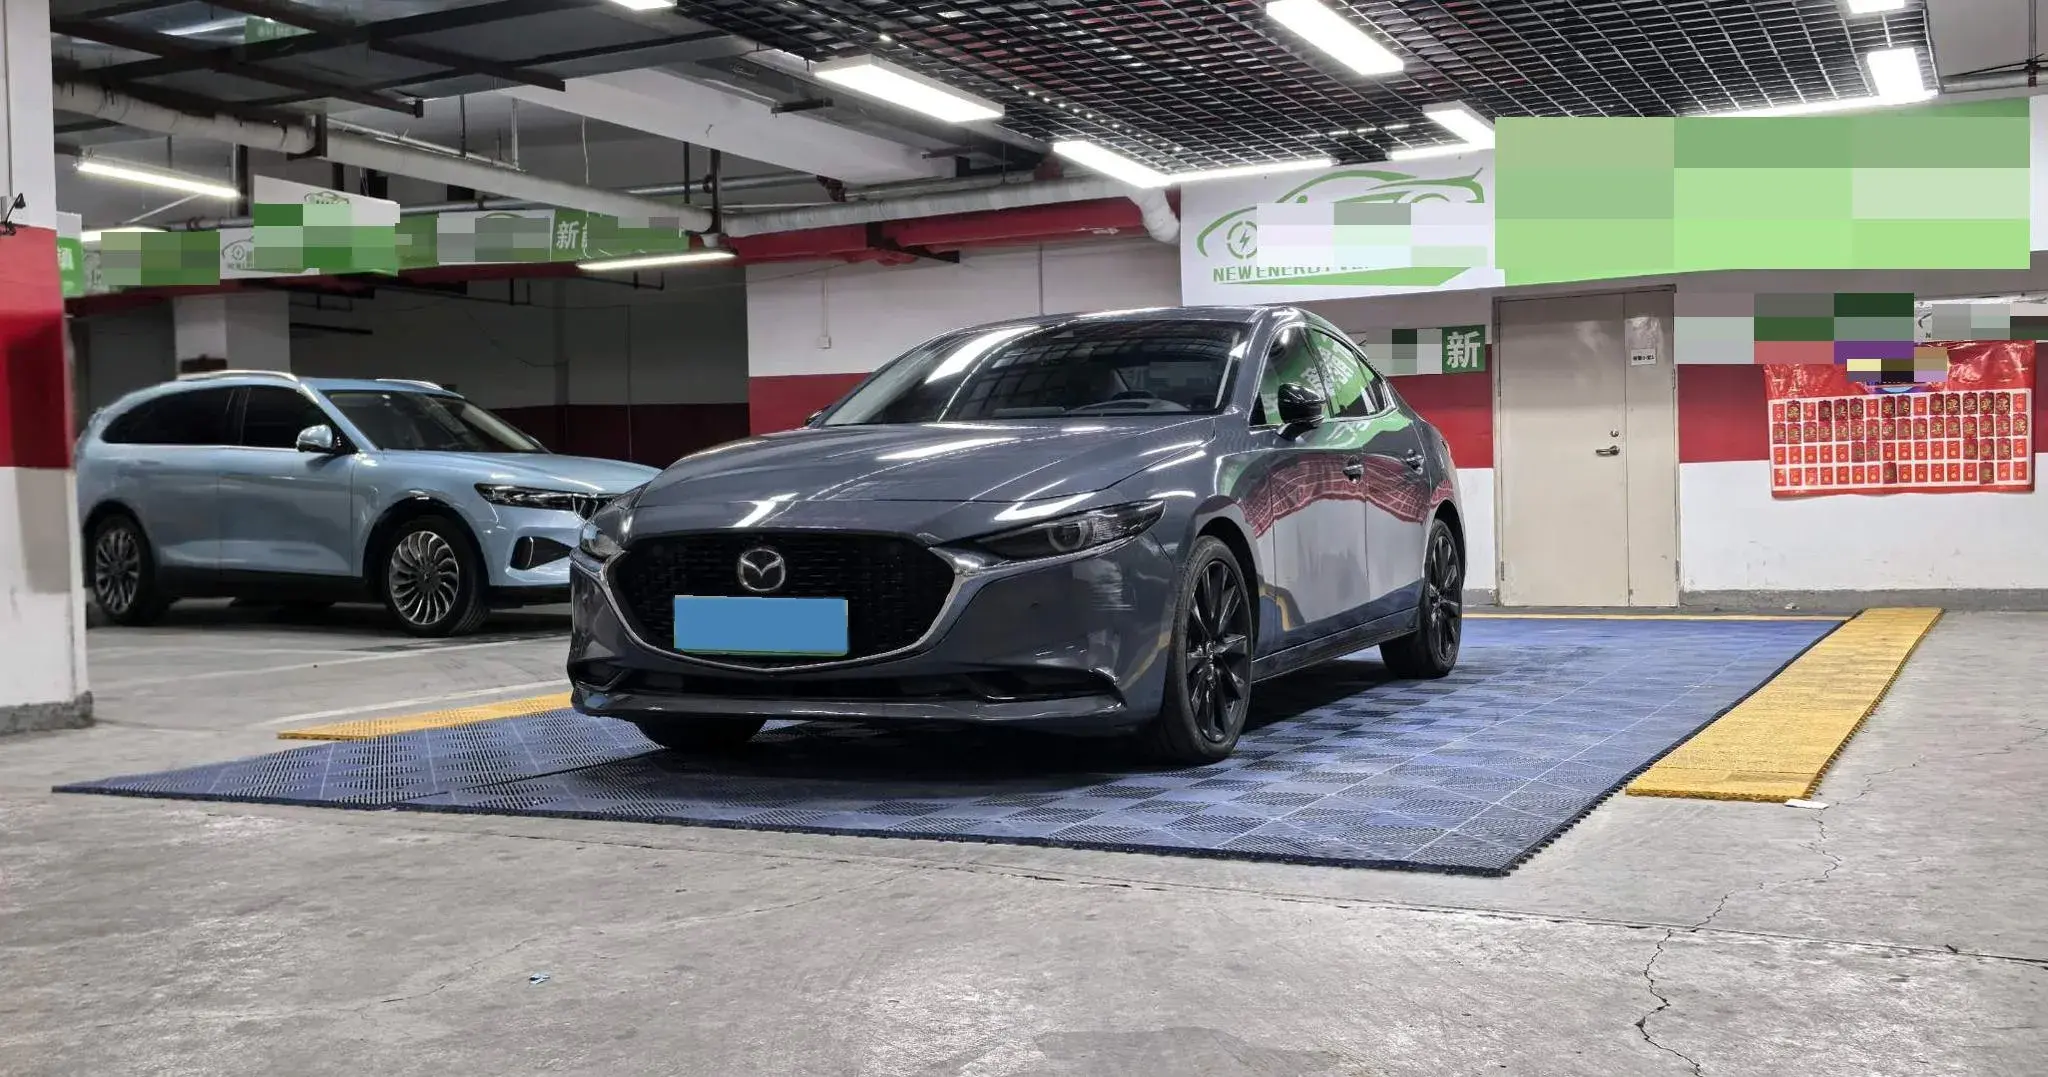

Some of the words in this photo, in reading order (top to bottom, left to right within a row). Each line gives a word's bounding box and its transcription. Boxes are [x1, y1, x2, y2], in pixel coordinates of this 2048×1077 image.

[556, 220, 588, 249] 新
[1213, 266, 1251, 282] NEW
[1446, 331, 1481, 368] 新
